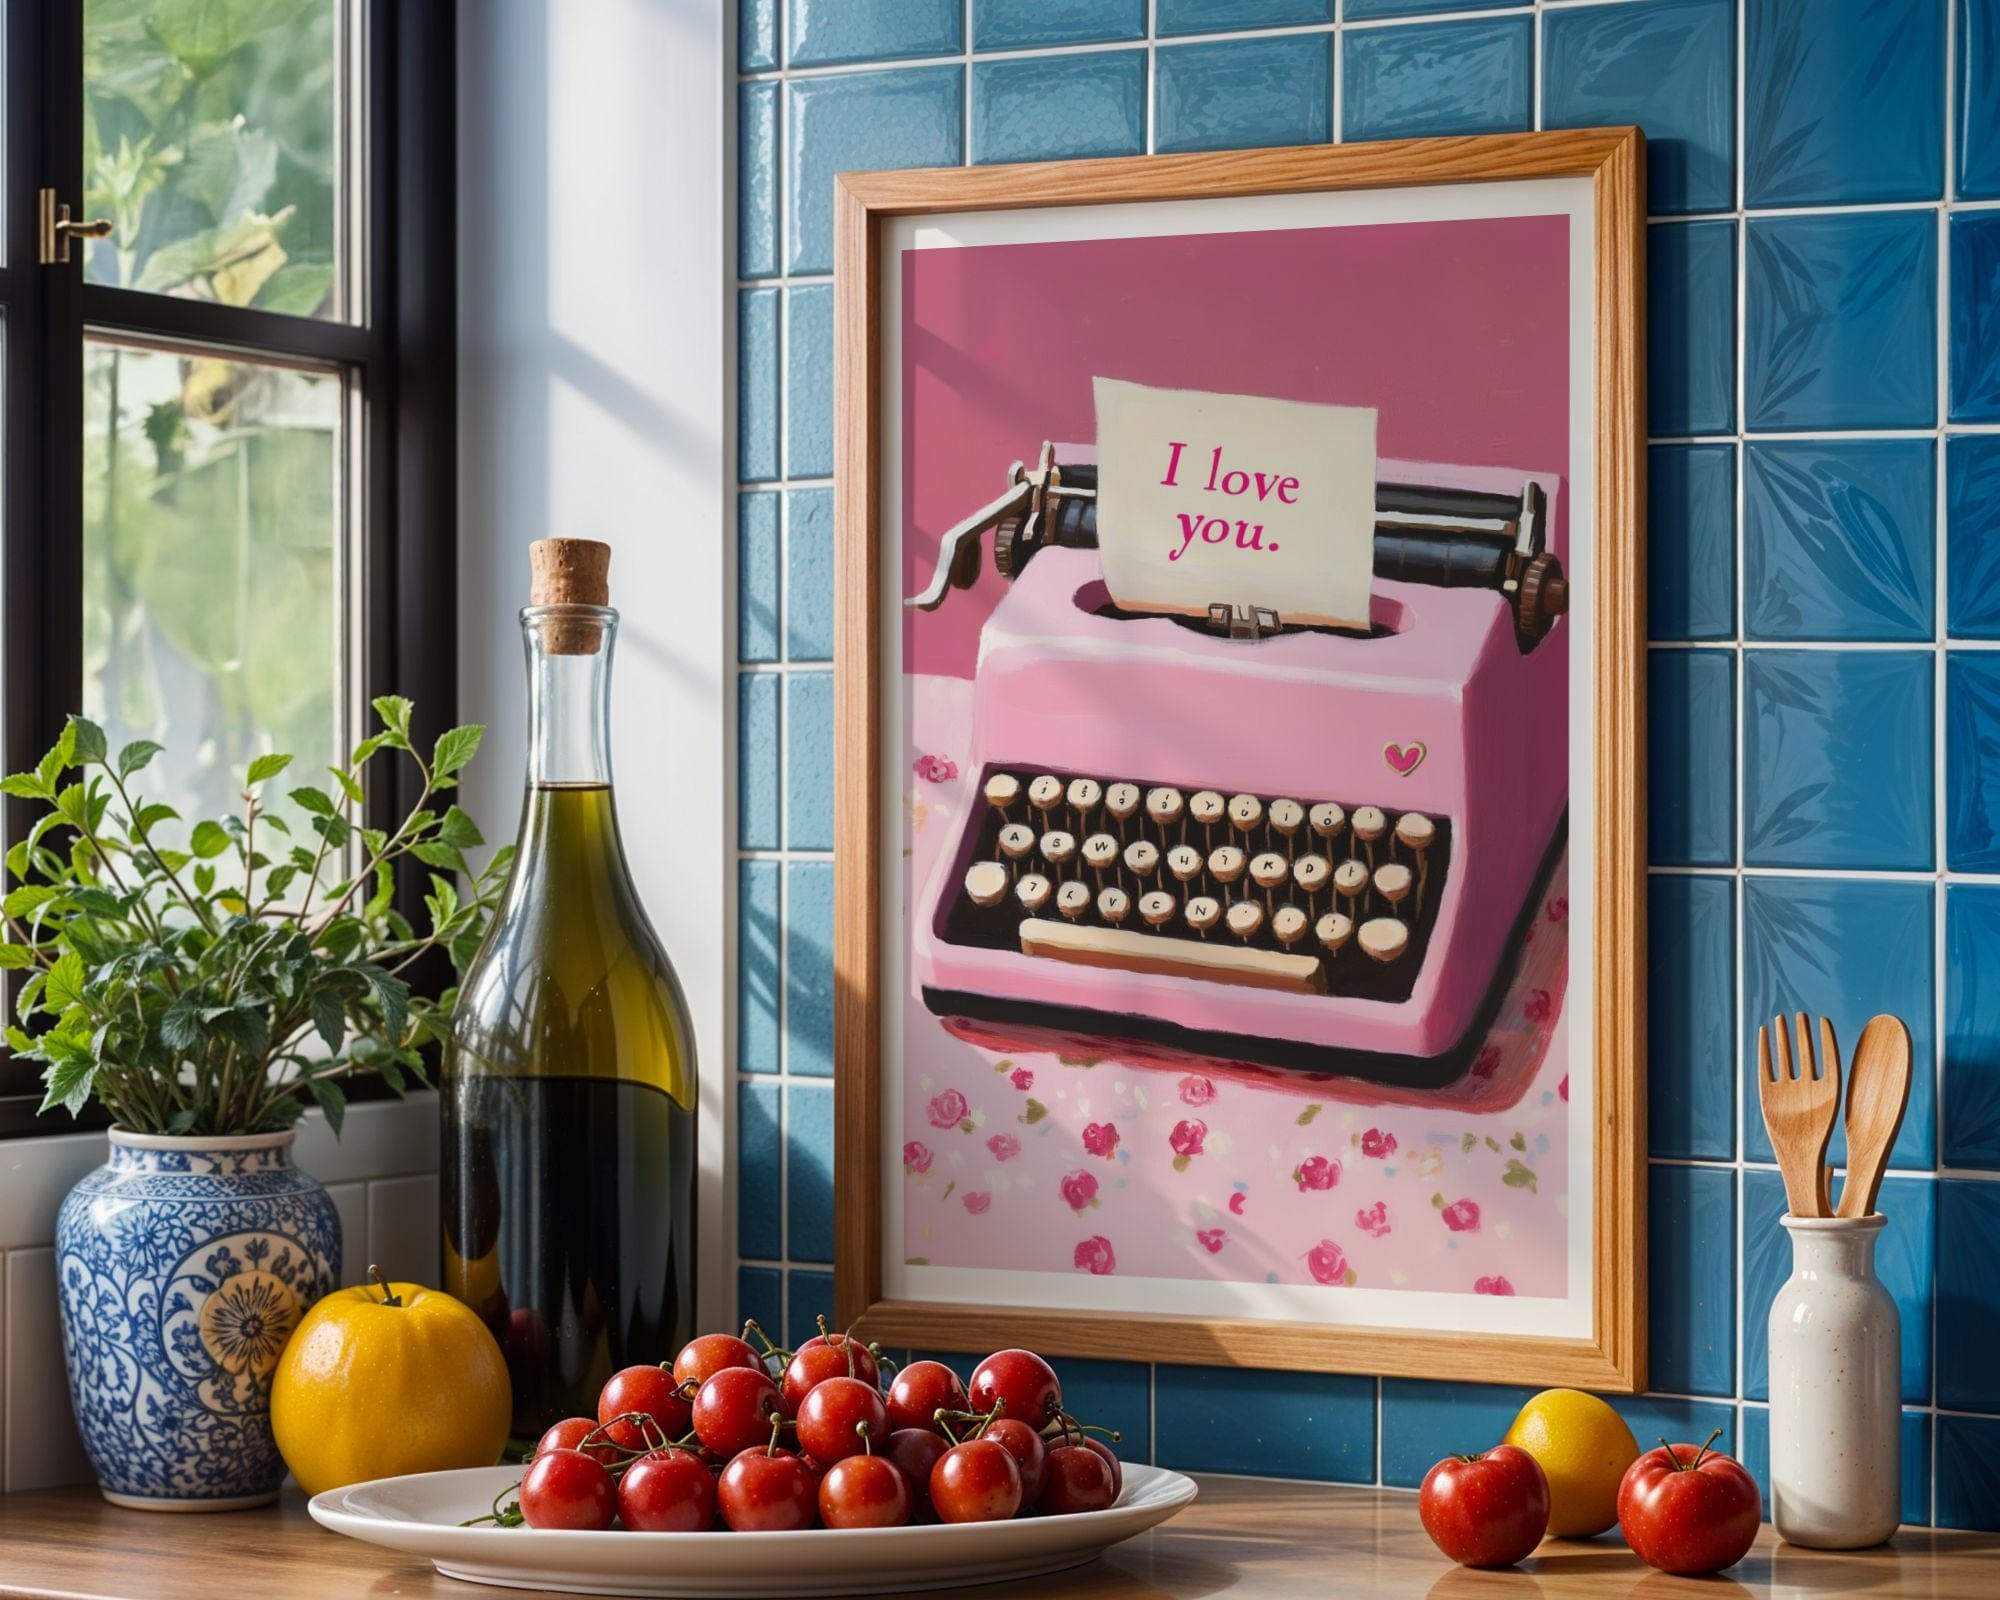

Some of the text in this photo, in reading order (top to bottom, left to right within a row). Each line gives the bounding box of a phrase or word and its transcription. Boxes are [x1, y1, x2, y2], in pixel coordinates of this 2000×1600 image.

[1160, 442, 1300, 504] I love
[1168, 513, 1280, 562] you.
[1009, 831, 1020, 842] A
[1094, 841, 1109, 852] W
[1137, 849, 1147, 860] F
[1263, 860, 1274, 870] K
[1305, 863, 1314, 874] D
[1108, 897, 1118, 908] V
[1151, 900, 1160, 910] C
[1195, 904, 1207, 916] N
